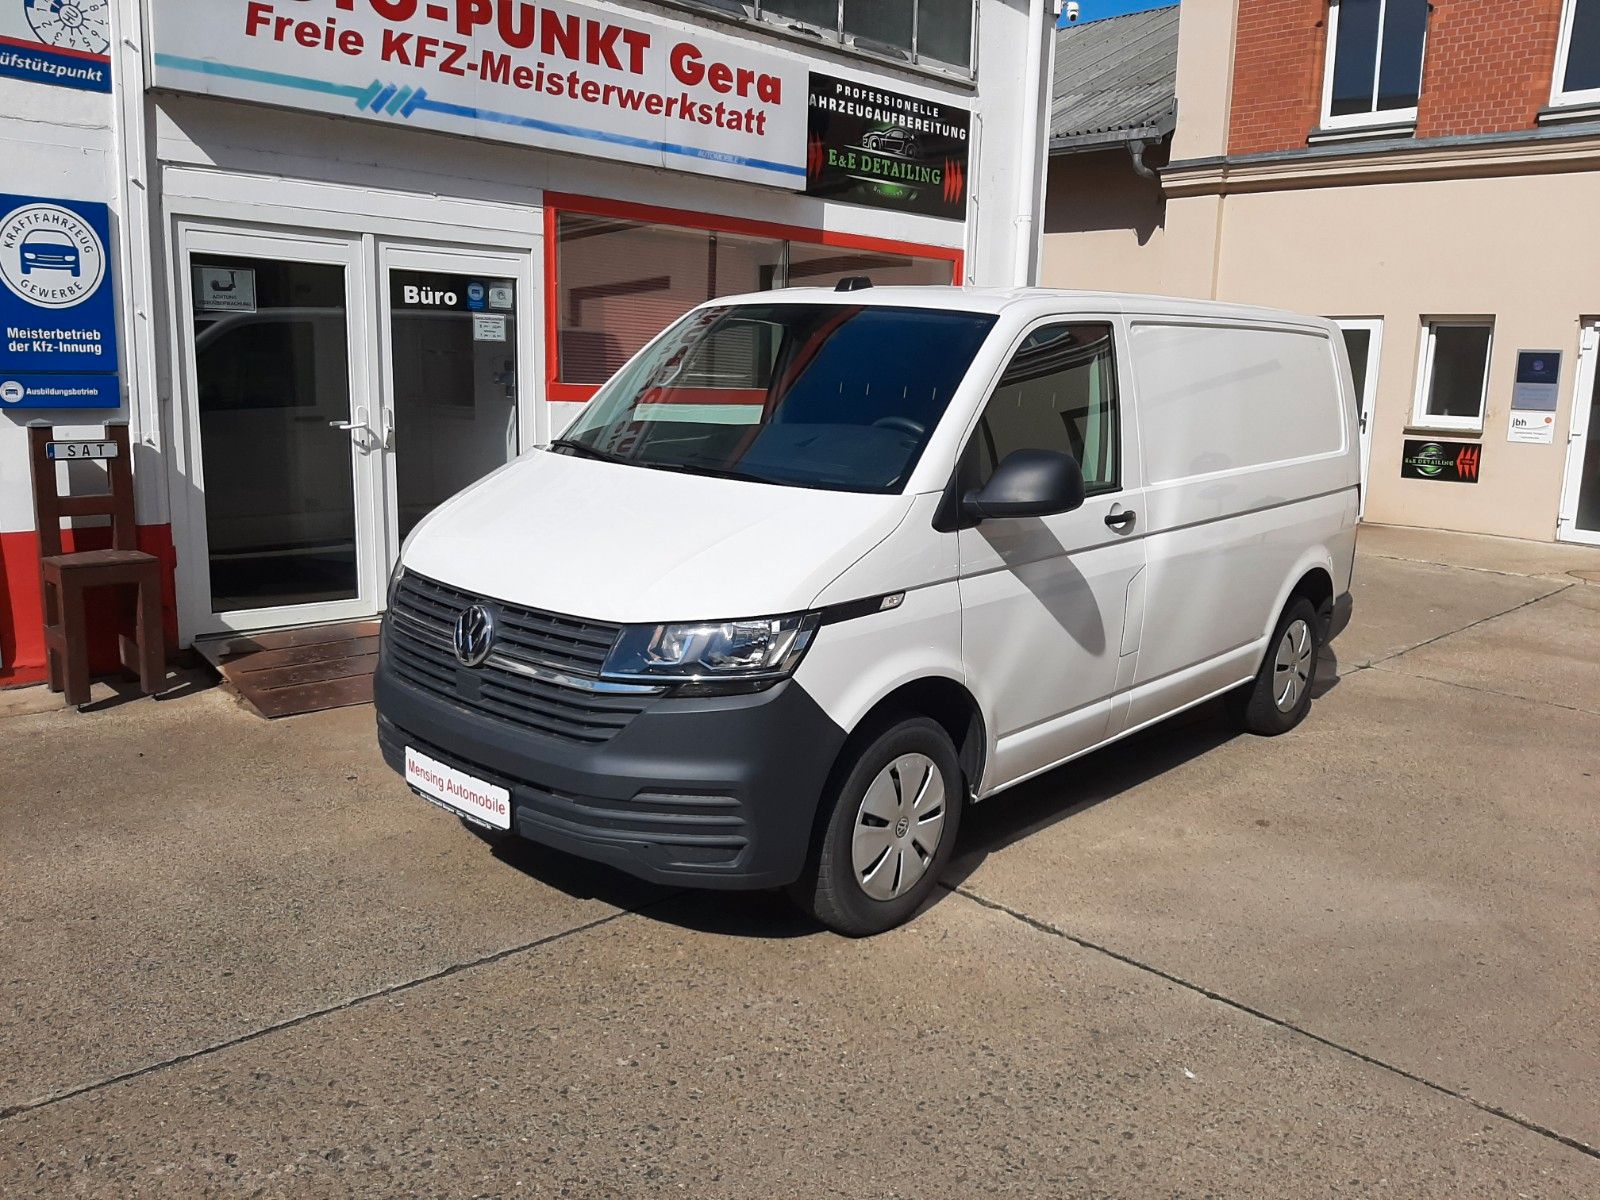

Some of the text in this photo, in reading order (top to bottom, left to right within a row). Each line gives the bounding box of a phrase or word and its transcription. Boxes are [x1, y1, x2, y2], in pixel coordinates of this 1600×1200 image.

[292, 0, 782, 105] -PUNKT Gera
[245, 2, 767, 136] Freie KFZ-Meisterwerkstatt
[836, 83, 940, 118] PROFESSIONELLE
[828, 149, 942, 185] E&E DETAILING
[4, 213, 94, 254] KRAFTFAHRZEUG
[20, 279, 83, 299] GEWERBE
[403, 285, 458, 306] Büro
[7, 327, 102, 340] Meisterbetrieb
[8, 340, 103, 356] der Kfz-Innung
[26, 387, 99, 397] Ausbildungsbetrieb
[1511, 417, 1528, 428] jbh
[407, 758, 445, 793] Mensing
[446, 778, 507, 816] Automobile
